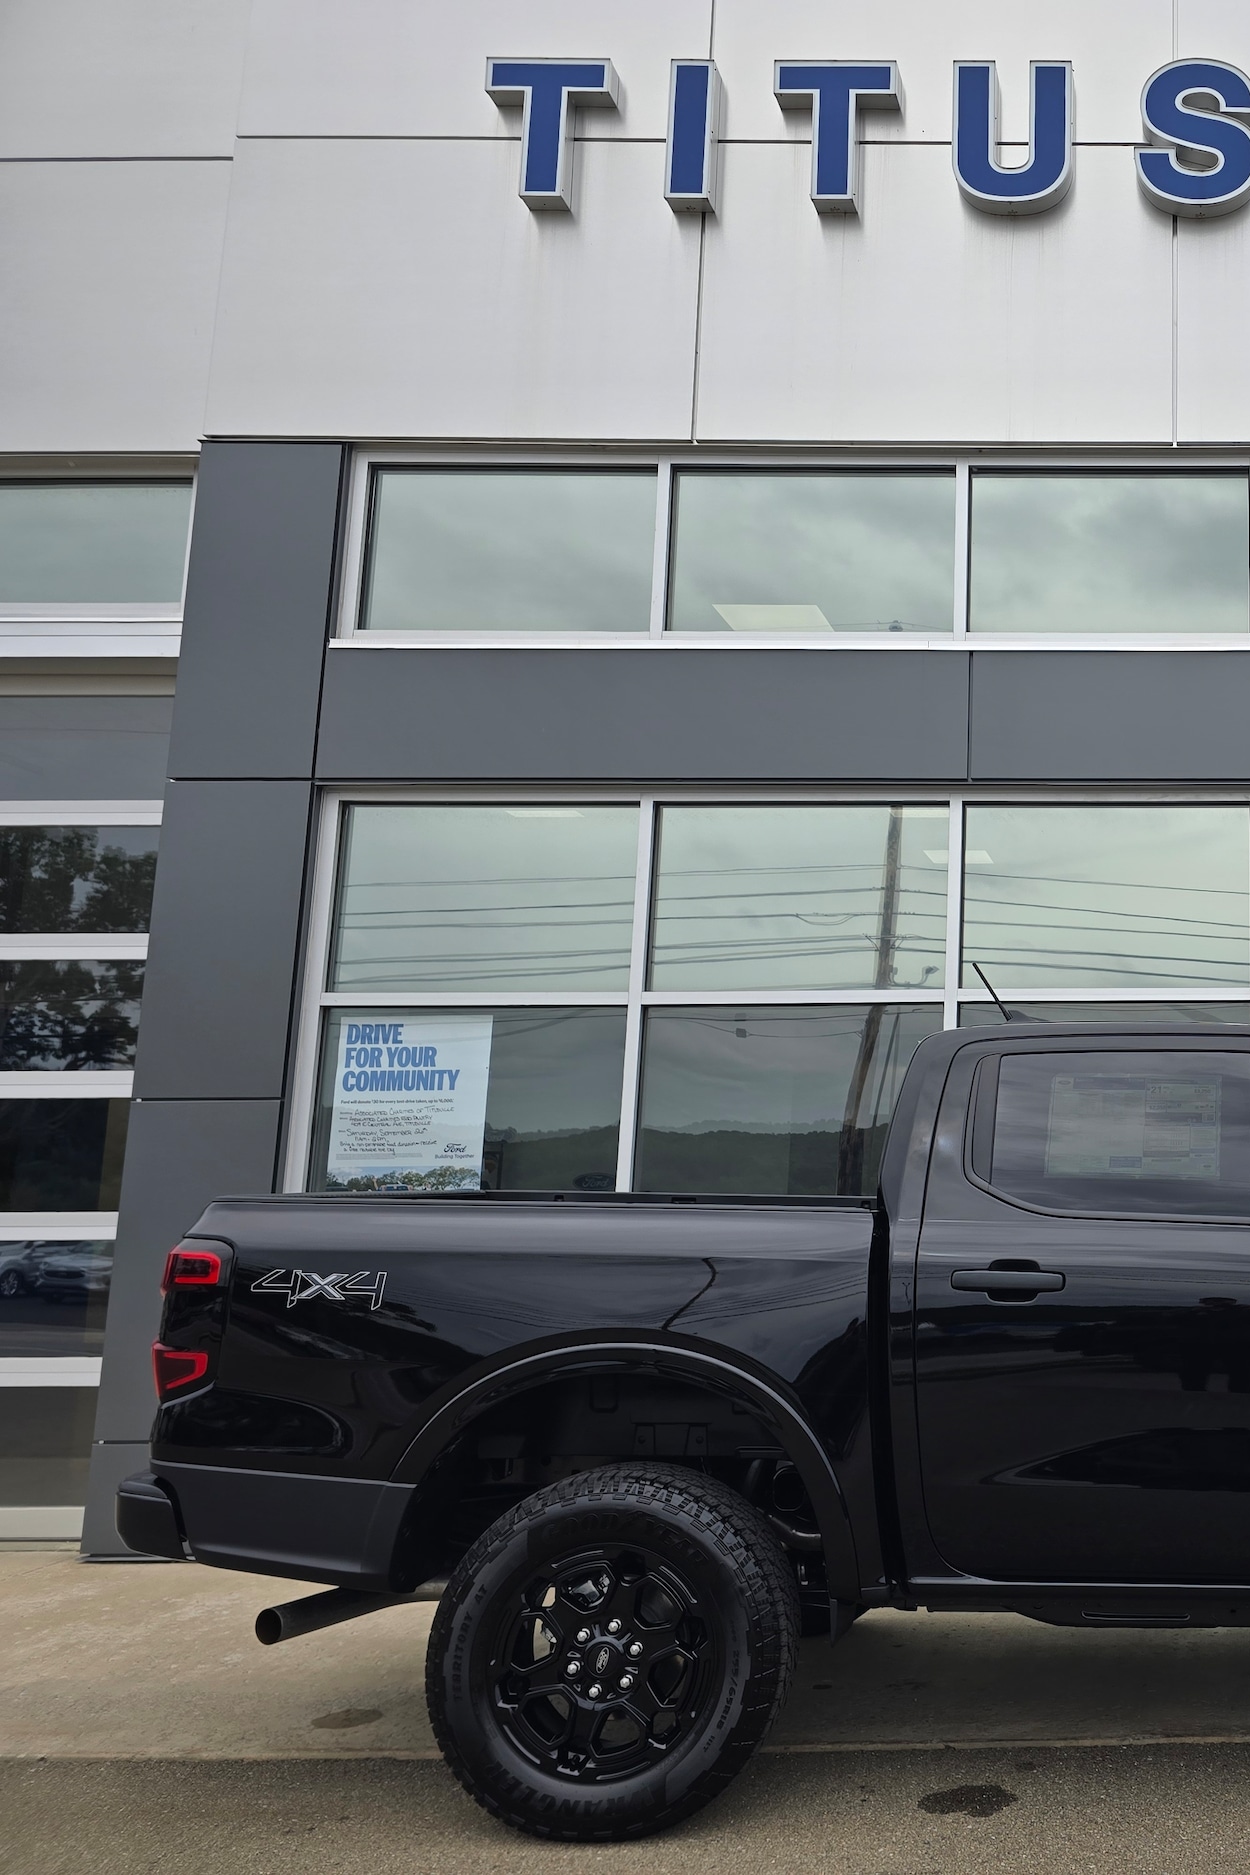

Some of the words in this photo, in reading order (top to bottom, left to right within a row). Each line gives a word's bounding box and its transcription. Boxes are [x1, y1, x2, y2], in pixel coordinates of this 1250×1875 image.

[346, 1023, 404, 1045] DRIVE
[344, 1047, 383, 1069] FOR
[387, 1046, 437, 1068] YOUR
[342, 1069, 460, 1092] COMMUNITY
[443, 1143, 467, 1153] Ford
[452, 1611, 473, 1702] TERRITORY
[474, 1583, 488, 1605] AT
